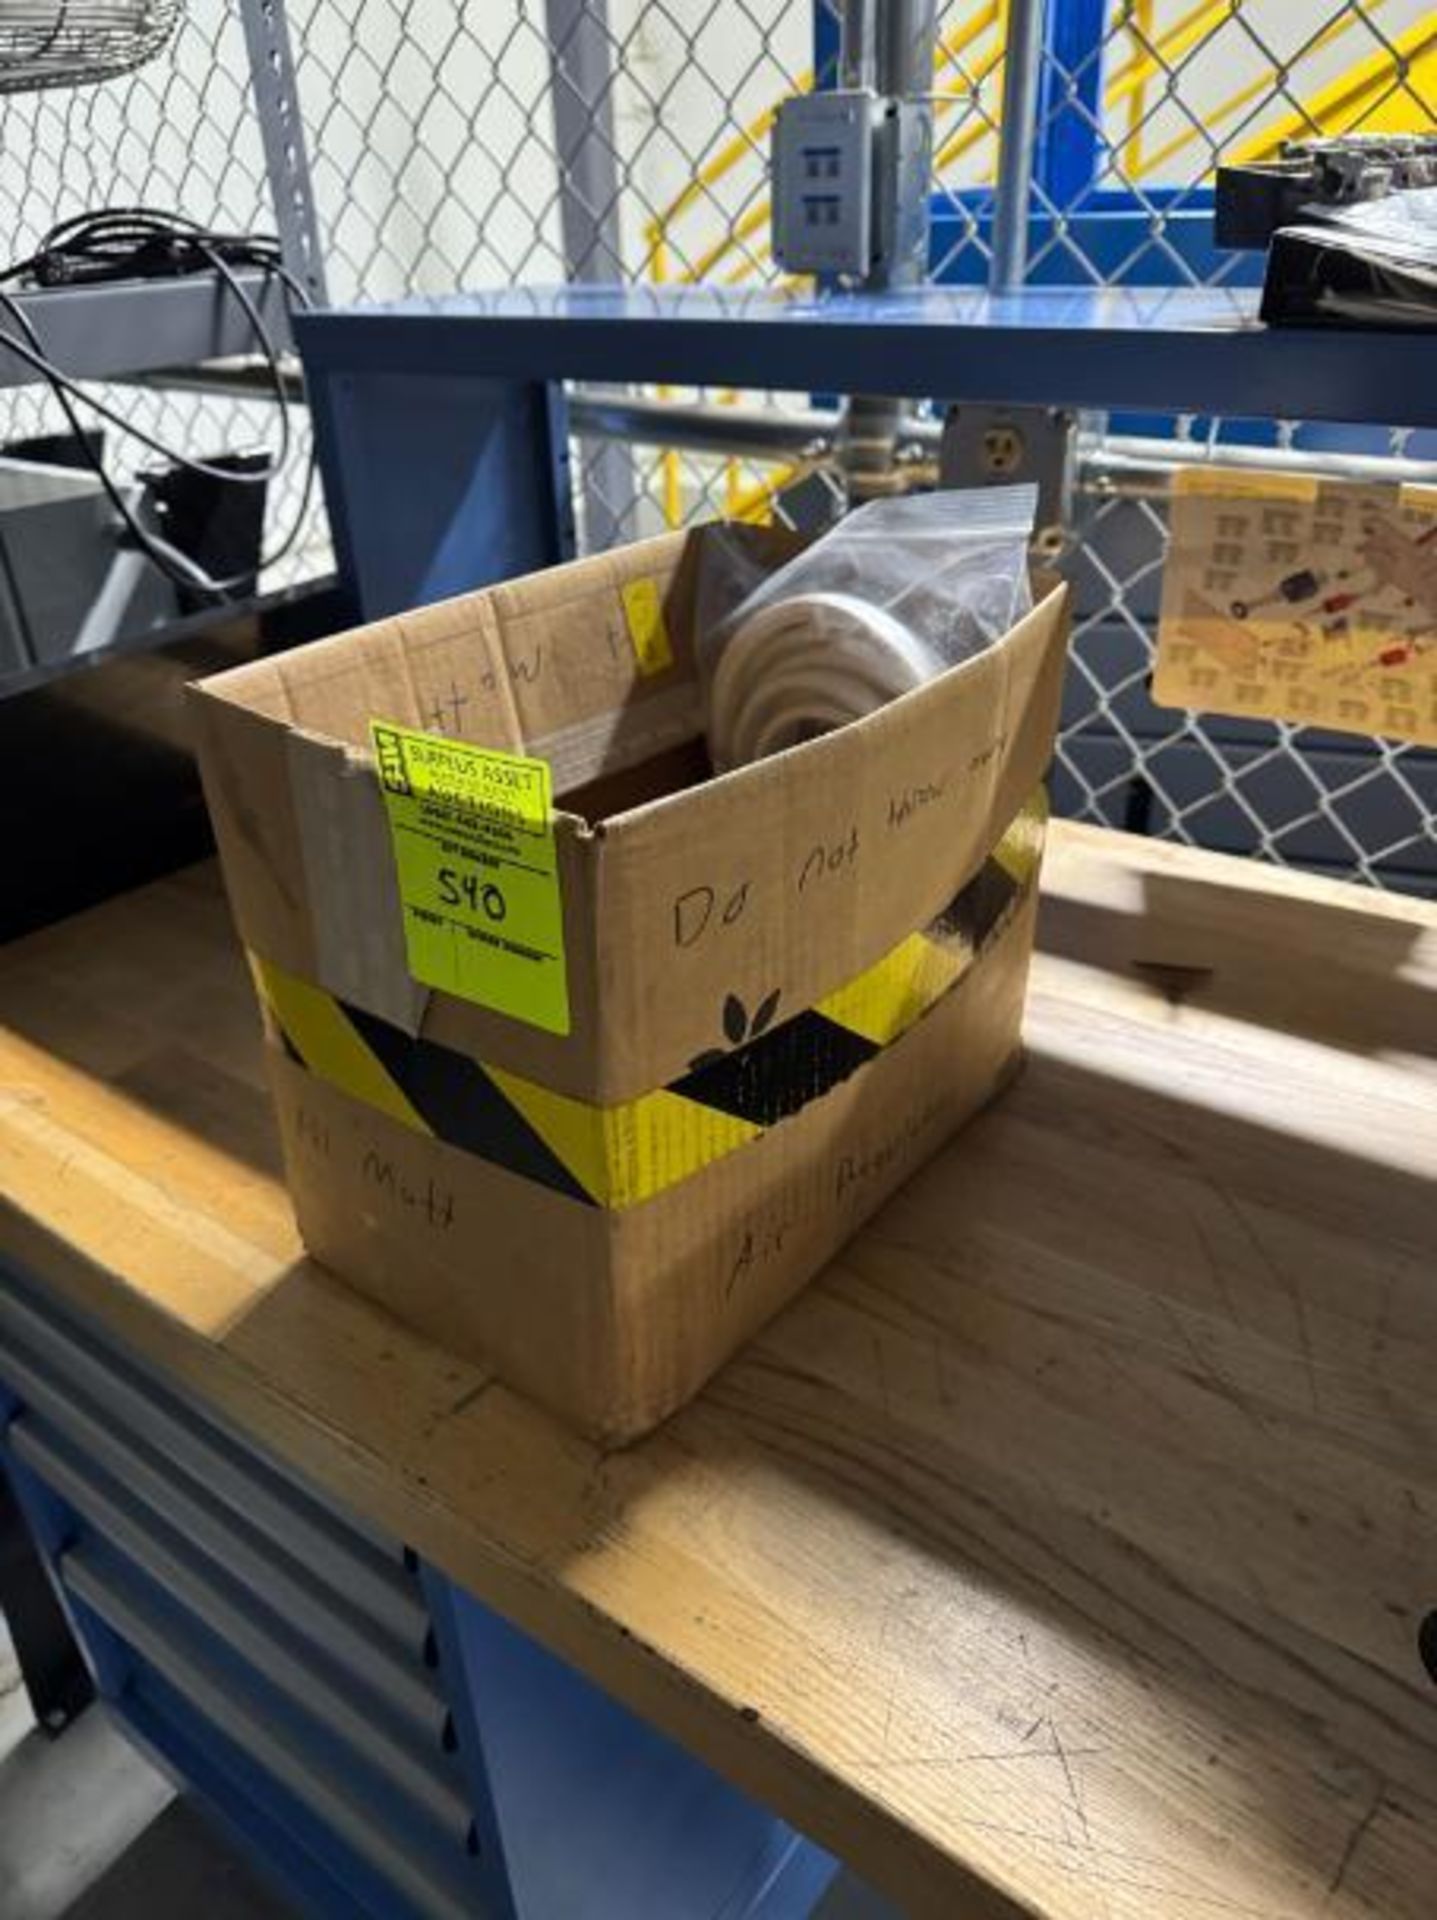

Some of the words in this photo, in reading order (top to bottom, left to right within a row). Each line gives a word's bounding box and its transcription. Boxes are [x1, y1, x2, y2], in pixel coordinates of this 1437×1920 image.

[482, 764, 533, 791] ASSET
[674, 882, 749, 947] Do
[798, 827, 860, 893] not
